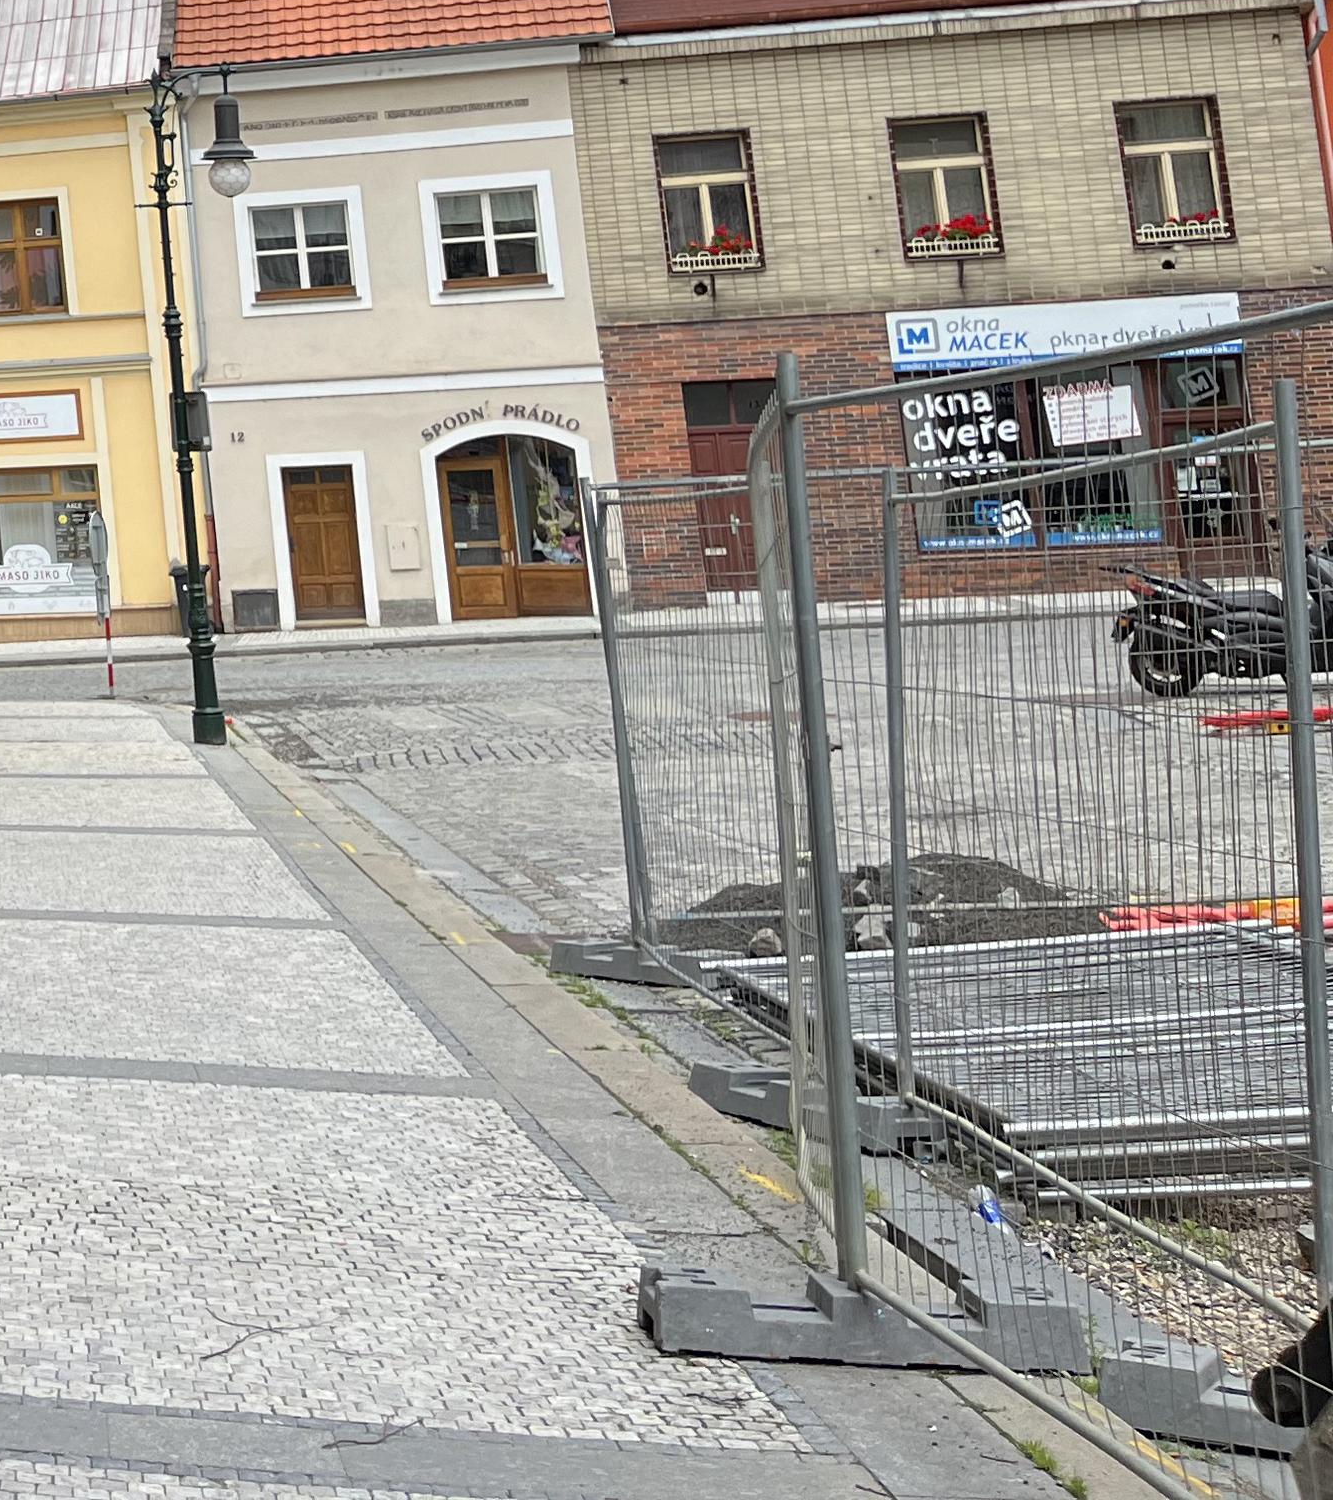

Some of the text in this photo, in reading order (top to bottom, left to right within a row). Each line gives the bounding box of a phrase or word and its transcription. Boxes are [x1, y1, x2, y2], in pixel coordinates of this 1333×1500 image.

[946, 316, 1000, 334] okna
[948, 332, 1030, 353] MACEK
[1049, 331, 1099, 349] okna
[902, 390, 993, 421] okna
[18, 417, 39, 427] JIKO
[502, 403, 580, 432] PRÁDLO
[230, 432, 245, 443] 12
[913, 414, 1020, 452] dveře
[33, 569, 61, 581] JIKO
